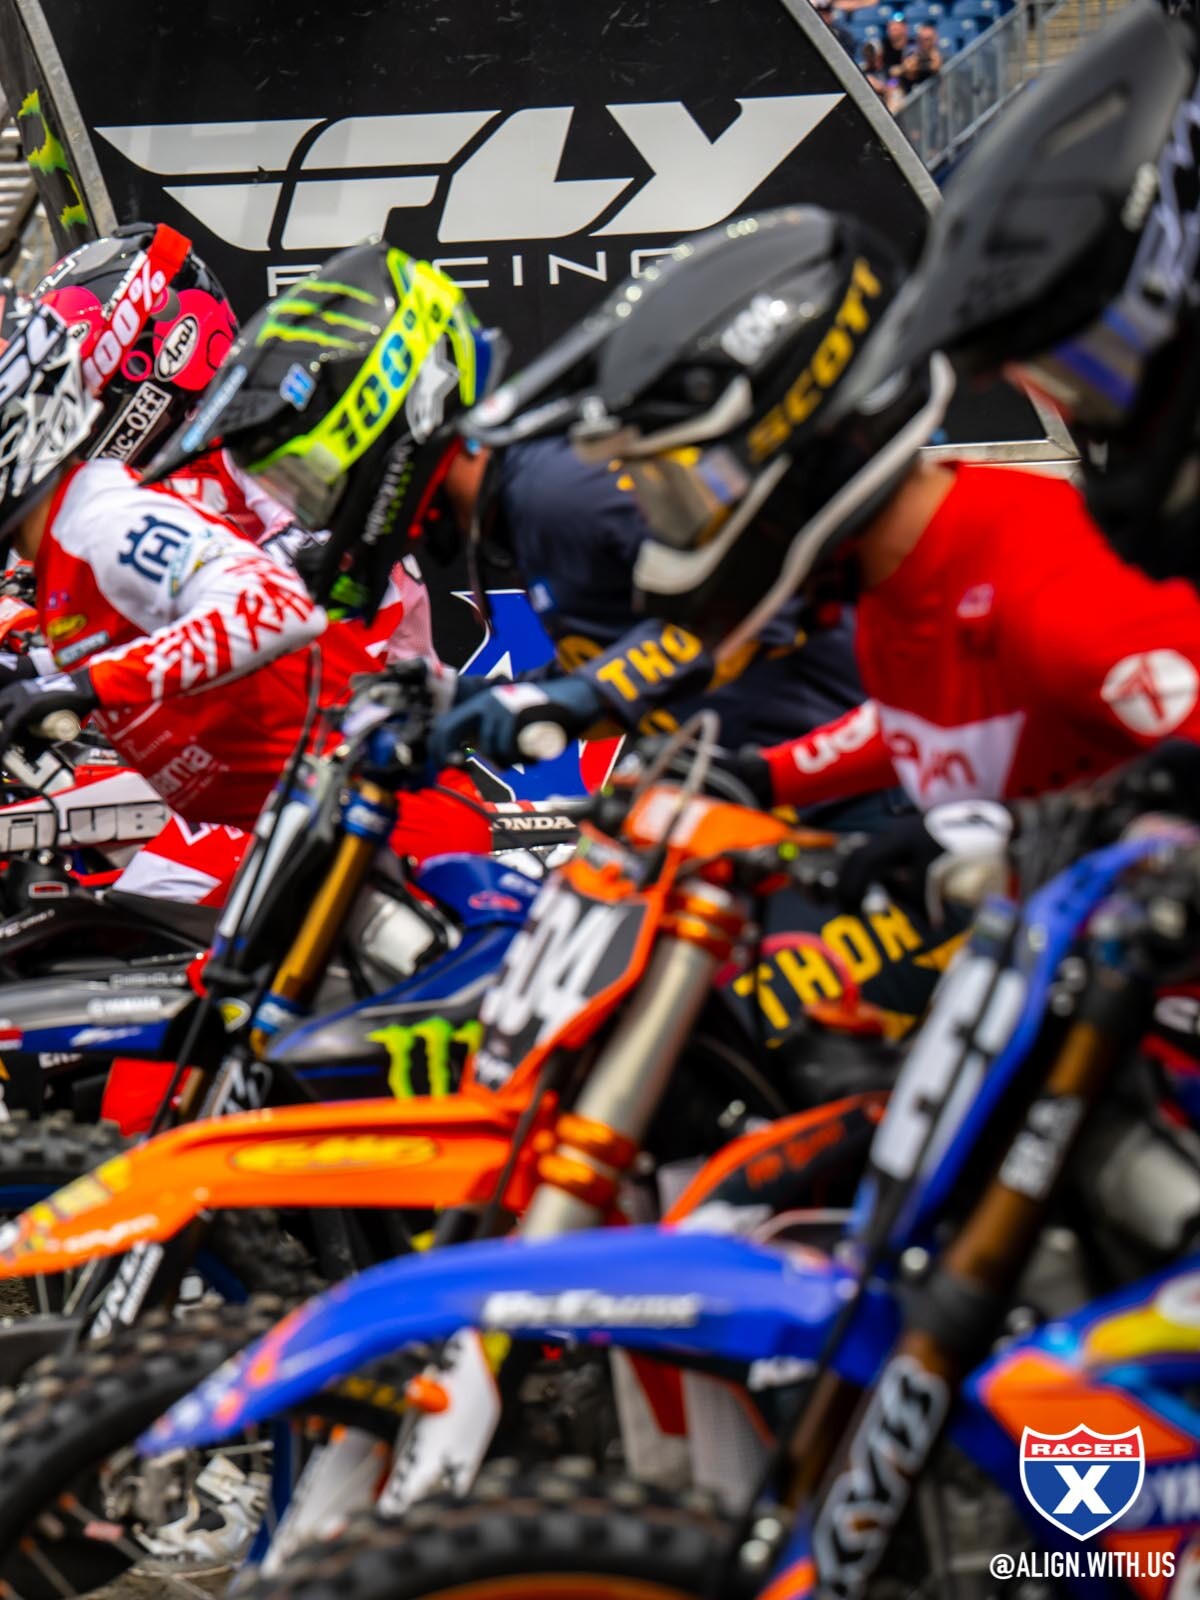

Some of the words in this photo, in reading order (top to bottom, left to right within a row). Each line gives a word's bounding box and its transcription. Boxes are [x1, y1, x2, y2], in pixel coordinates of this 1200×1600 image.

[97, 93, 846, 251] FLY
[267, 247, 668, 298] RCING
[596, 623, 704, 702] THO
[490, 815, 577, 831] ONDA
